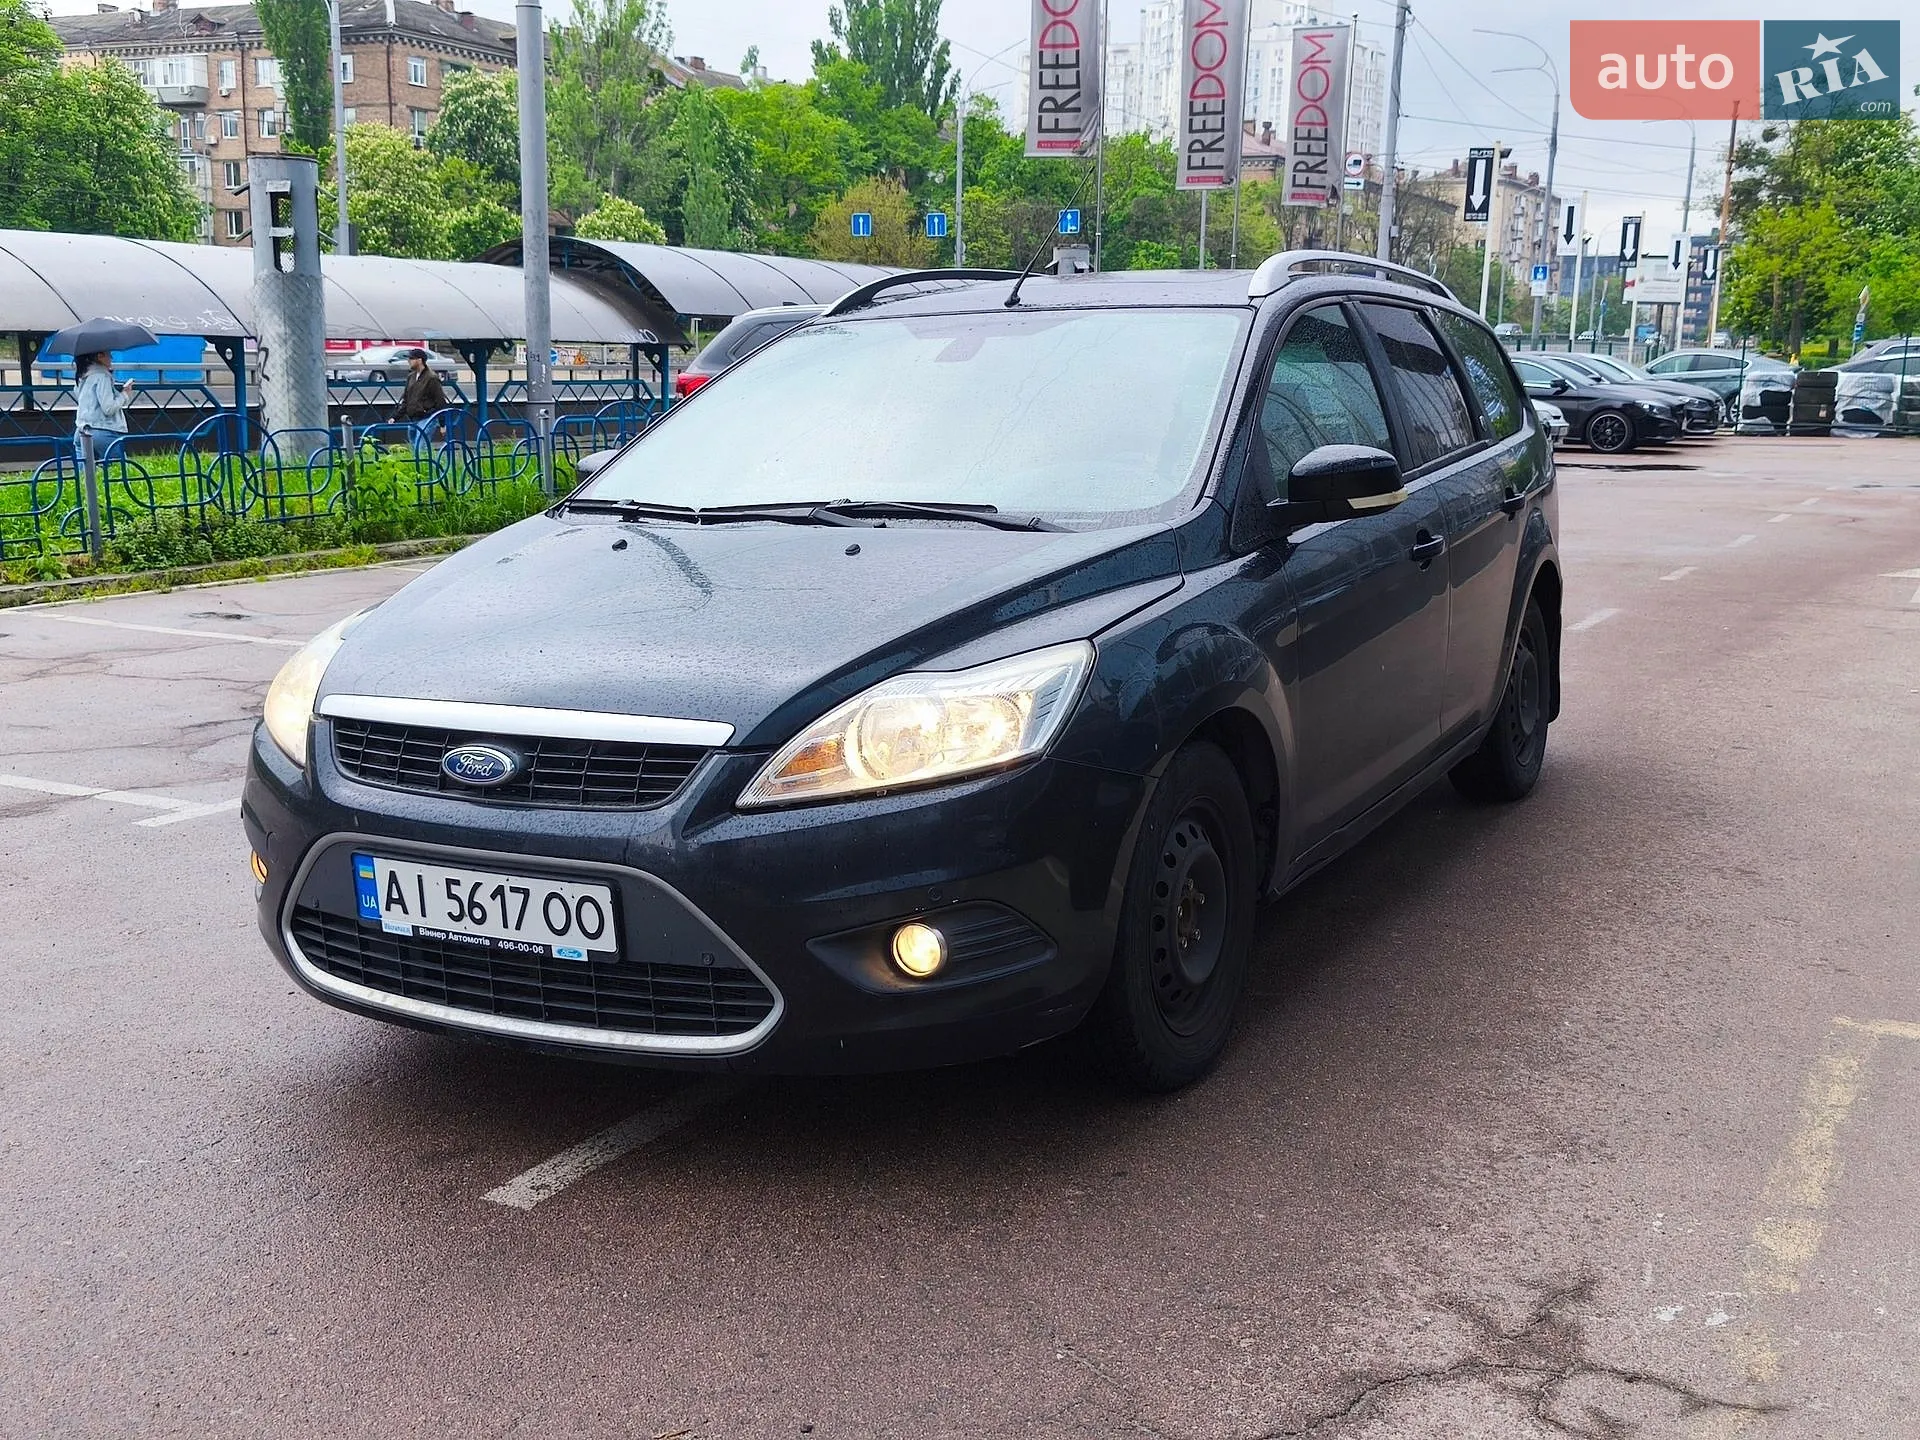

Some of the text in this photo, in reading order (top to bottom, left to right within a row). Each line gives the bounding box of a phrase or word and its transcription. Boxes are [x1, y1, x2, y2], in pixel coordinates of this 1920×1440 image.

[1187, 0, 1229, 171] FREEDOM
[1292, 33, 1334, 190] FREEDOM
[455, 753, 495, 777] Ford
[361, 894, 378, 910] UA
[385, 870, 427, 918] AI
[445, 877, 530, 931] 5617
[419, 927, 447, 941] Віннер
[448, 931, 491, 947] Автомотів
[498, 940, 544, 954] 496-00-06
